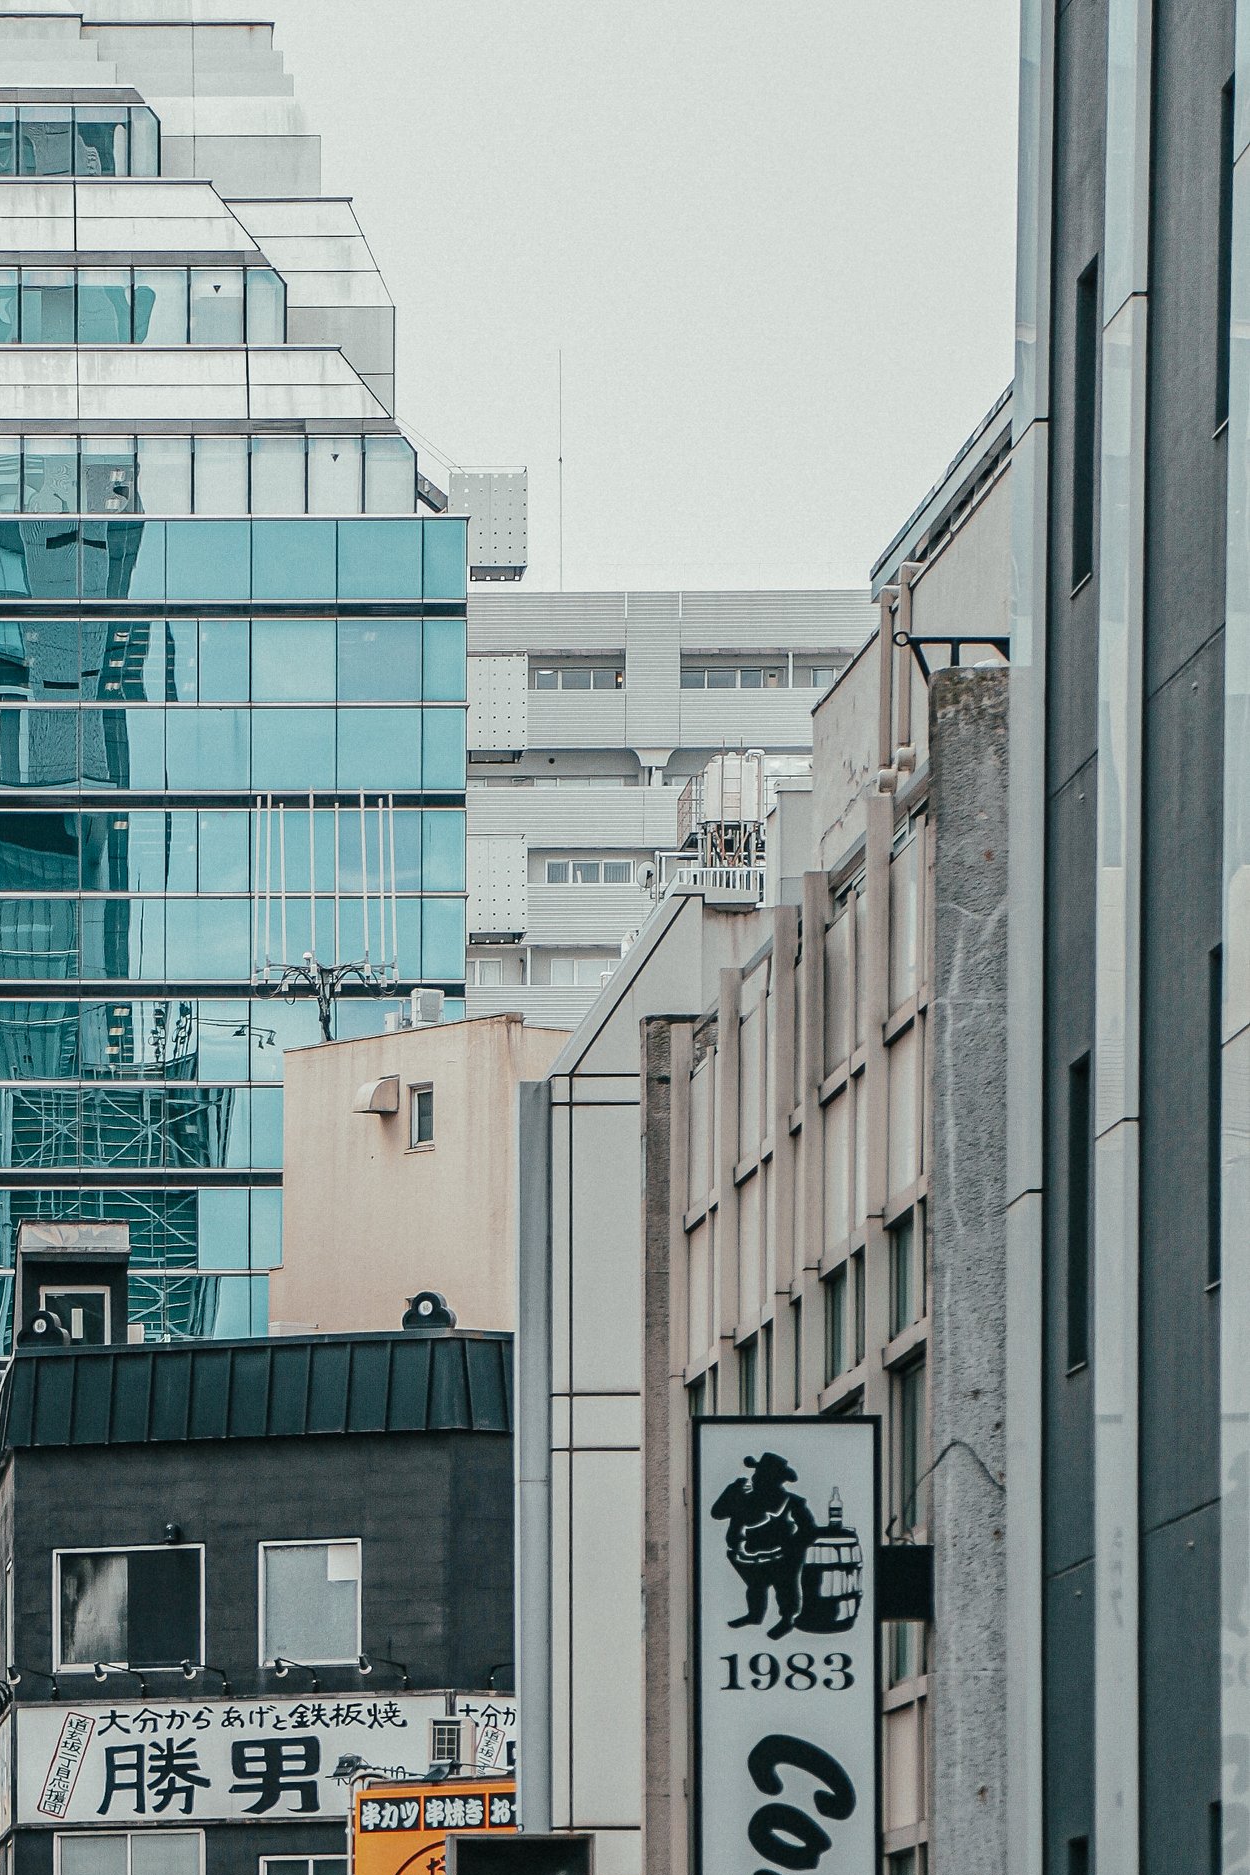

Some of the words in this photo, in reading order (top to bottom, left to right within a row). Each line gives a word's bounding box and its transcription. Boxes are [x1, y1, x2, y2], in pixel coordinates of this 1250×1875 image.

[719, 1652, 855, 1692] 1983
[96, 1736, 321, 1815] 勝男
[361, 1800, 421, 1831] 串カツ
[424, 1797, 484, 1828] 串焼き
